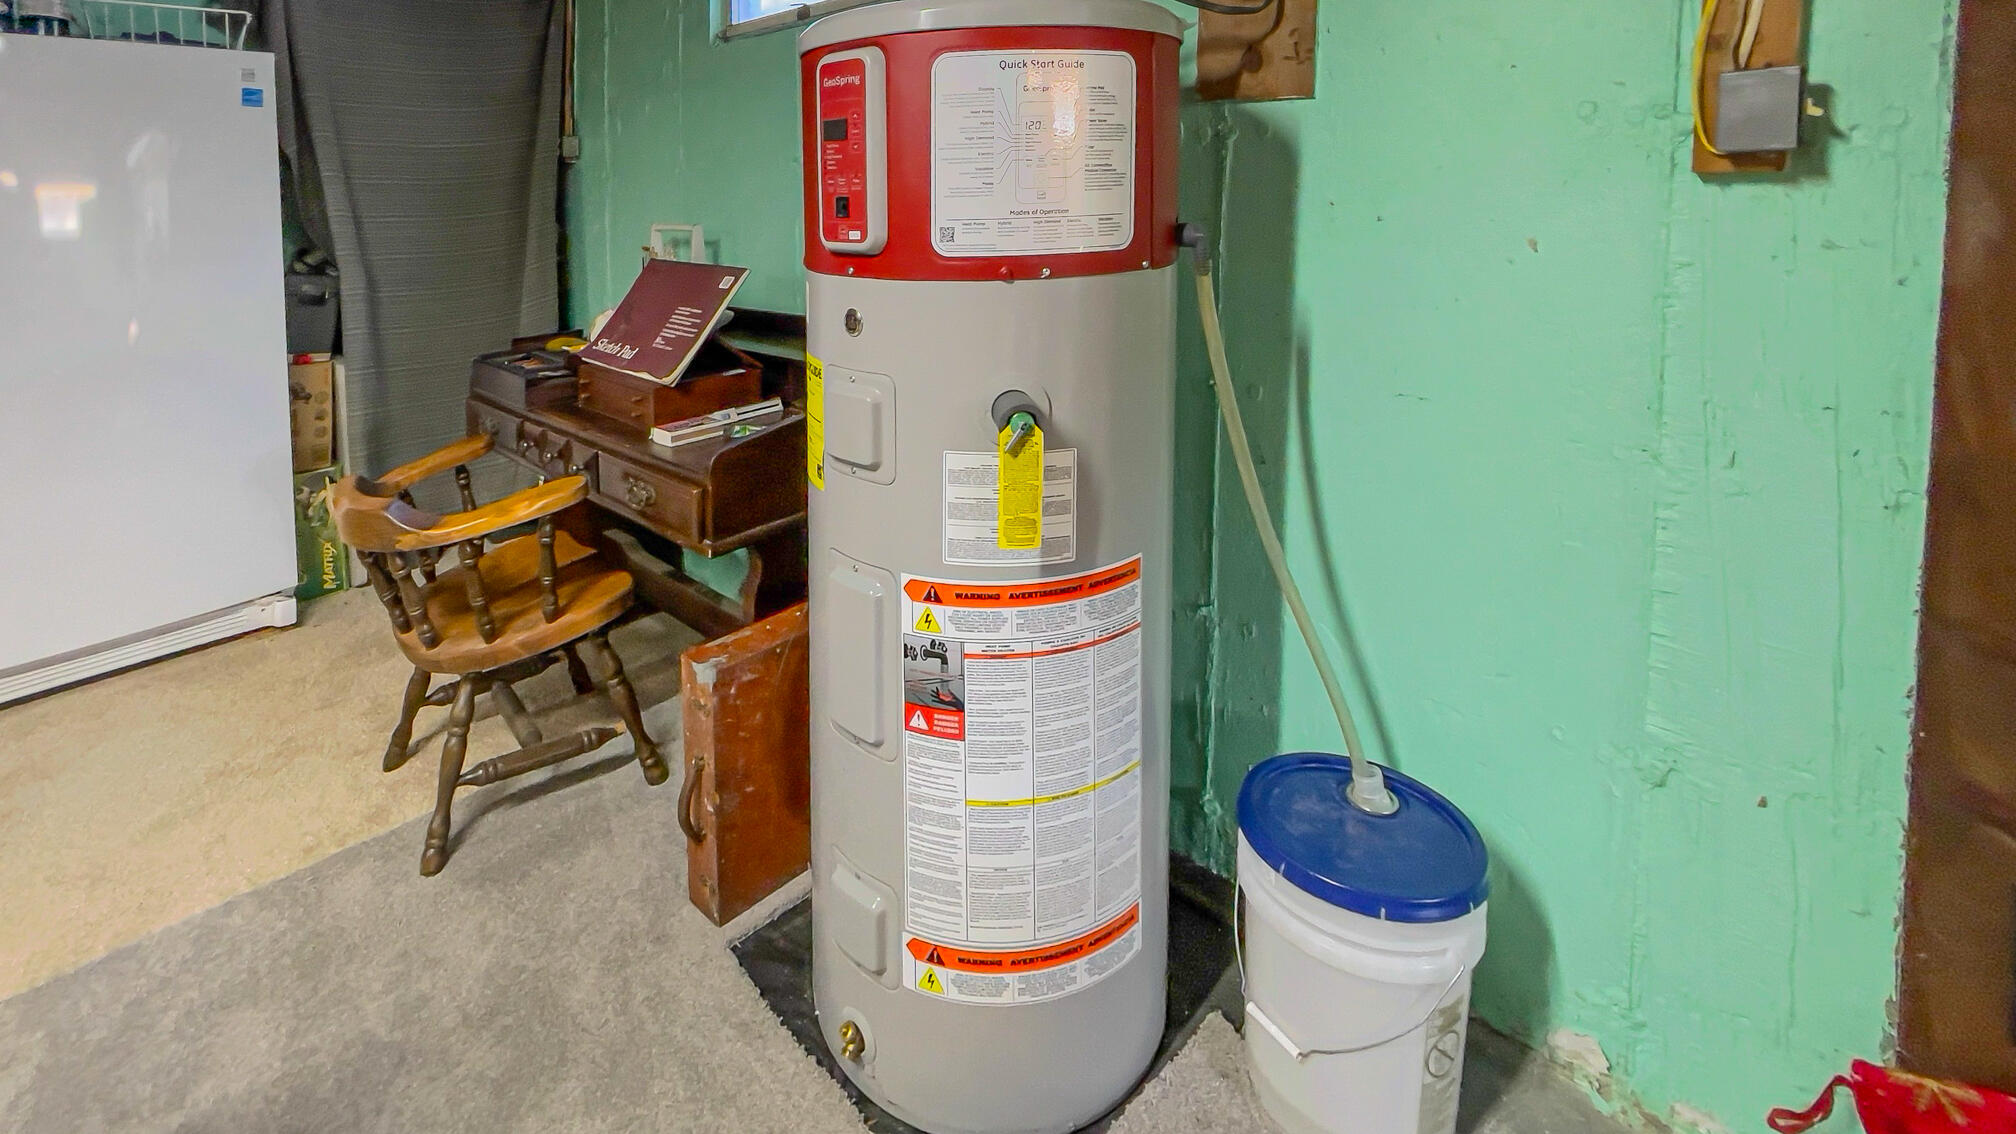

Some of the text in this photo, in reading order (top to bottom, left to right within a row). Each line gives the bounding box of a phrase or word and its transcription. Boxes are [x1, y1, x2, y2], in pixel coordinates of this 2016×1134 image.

[998, 59, 1085, 70] Quick Start Guide
[823, 74, 861, 88] GeoSpring
[1025, 120, 1042, 130] 120
[1031, 208, 1039, 216] of
[1039, 207, 1070, 216] Operation
[592, 338, 639, 360] Sketch Pad
[954, 567, 1137, 601] WARNING AVERTISSEMENT ADVERTENCIA
[957, 957, 1003, 967] WARNING
[1010, 943, 1085, 966] AVERTISSEMENT
